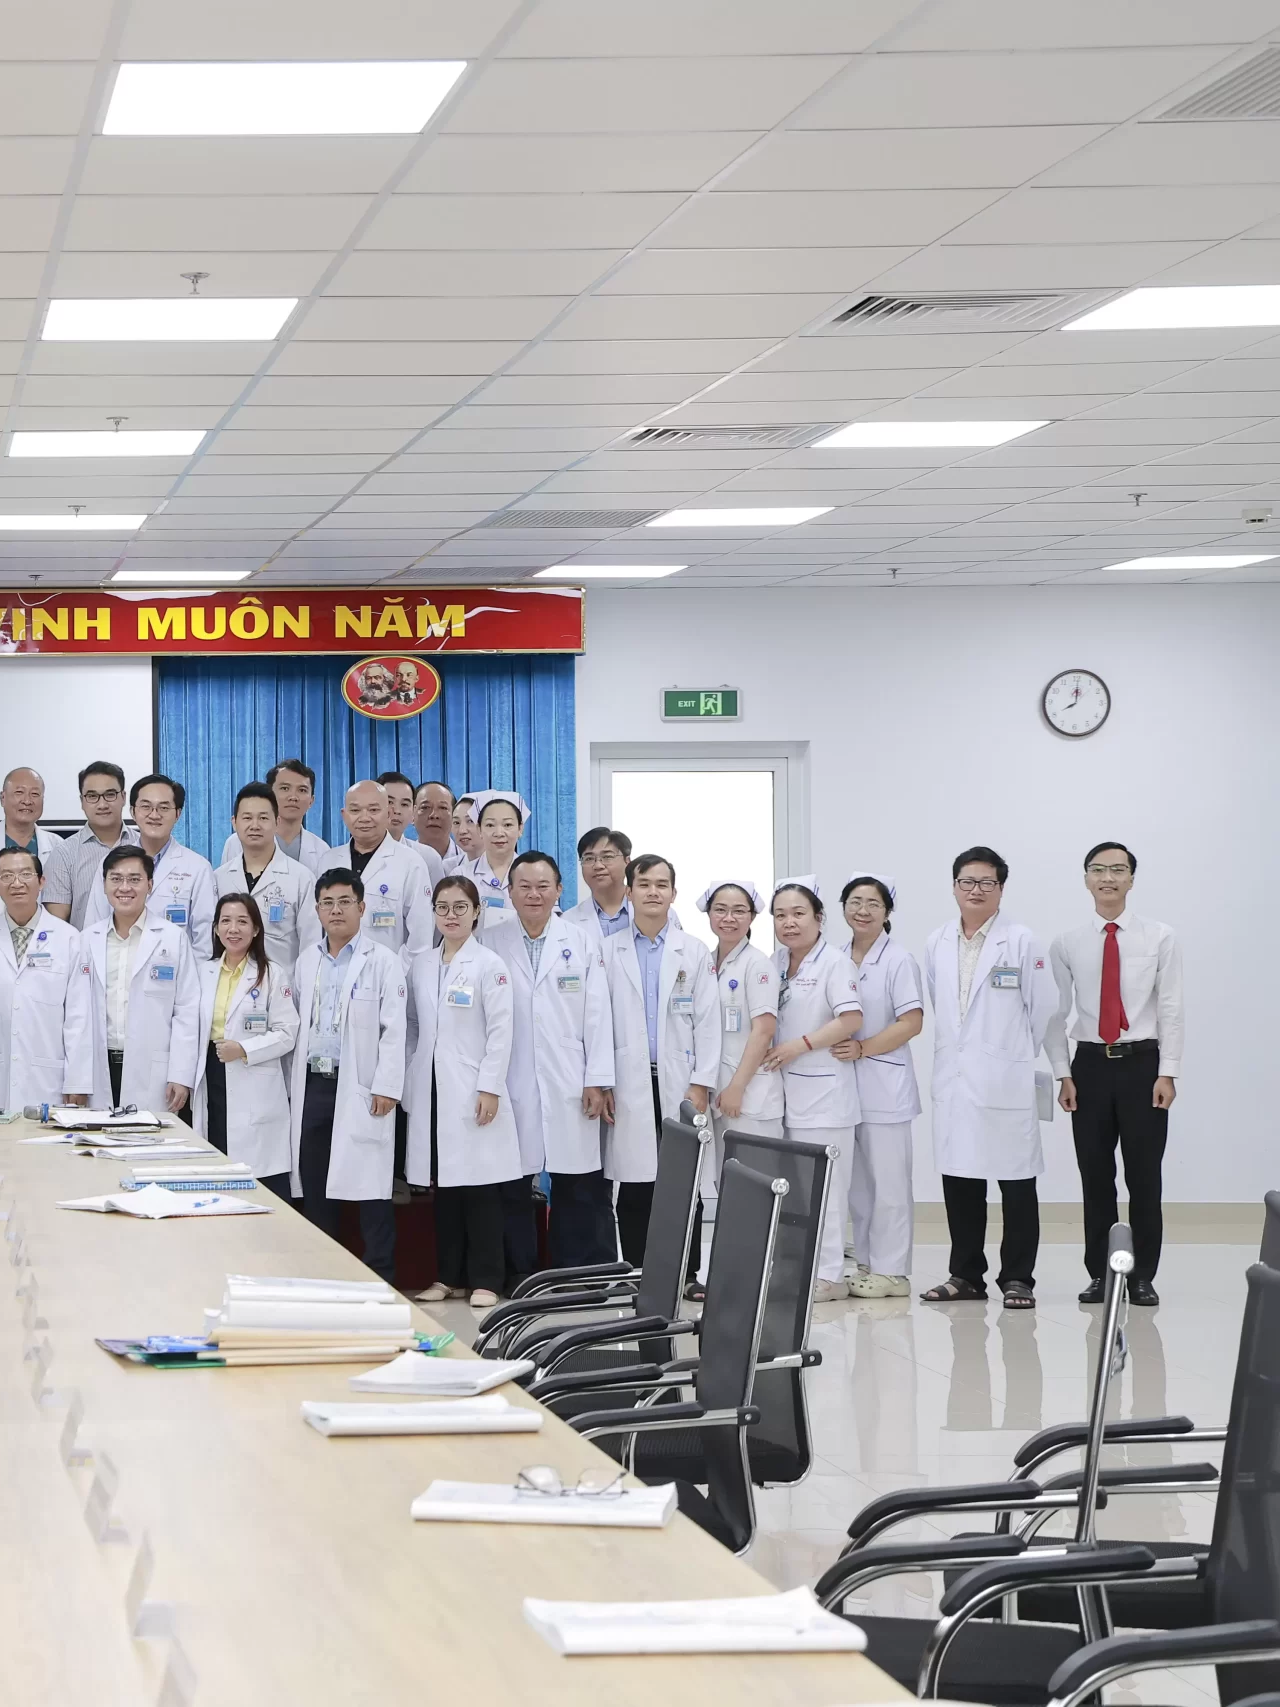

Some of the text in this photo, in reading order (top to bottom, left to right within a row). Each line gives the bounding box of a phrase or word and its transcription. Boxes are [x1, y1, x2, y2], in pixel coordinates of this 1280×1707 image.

[137, 596, 310, 641] MUÔN
[336, 597, 466, 639] NĂM
[678, 700, 696, 708] EXIT
